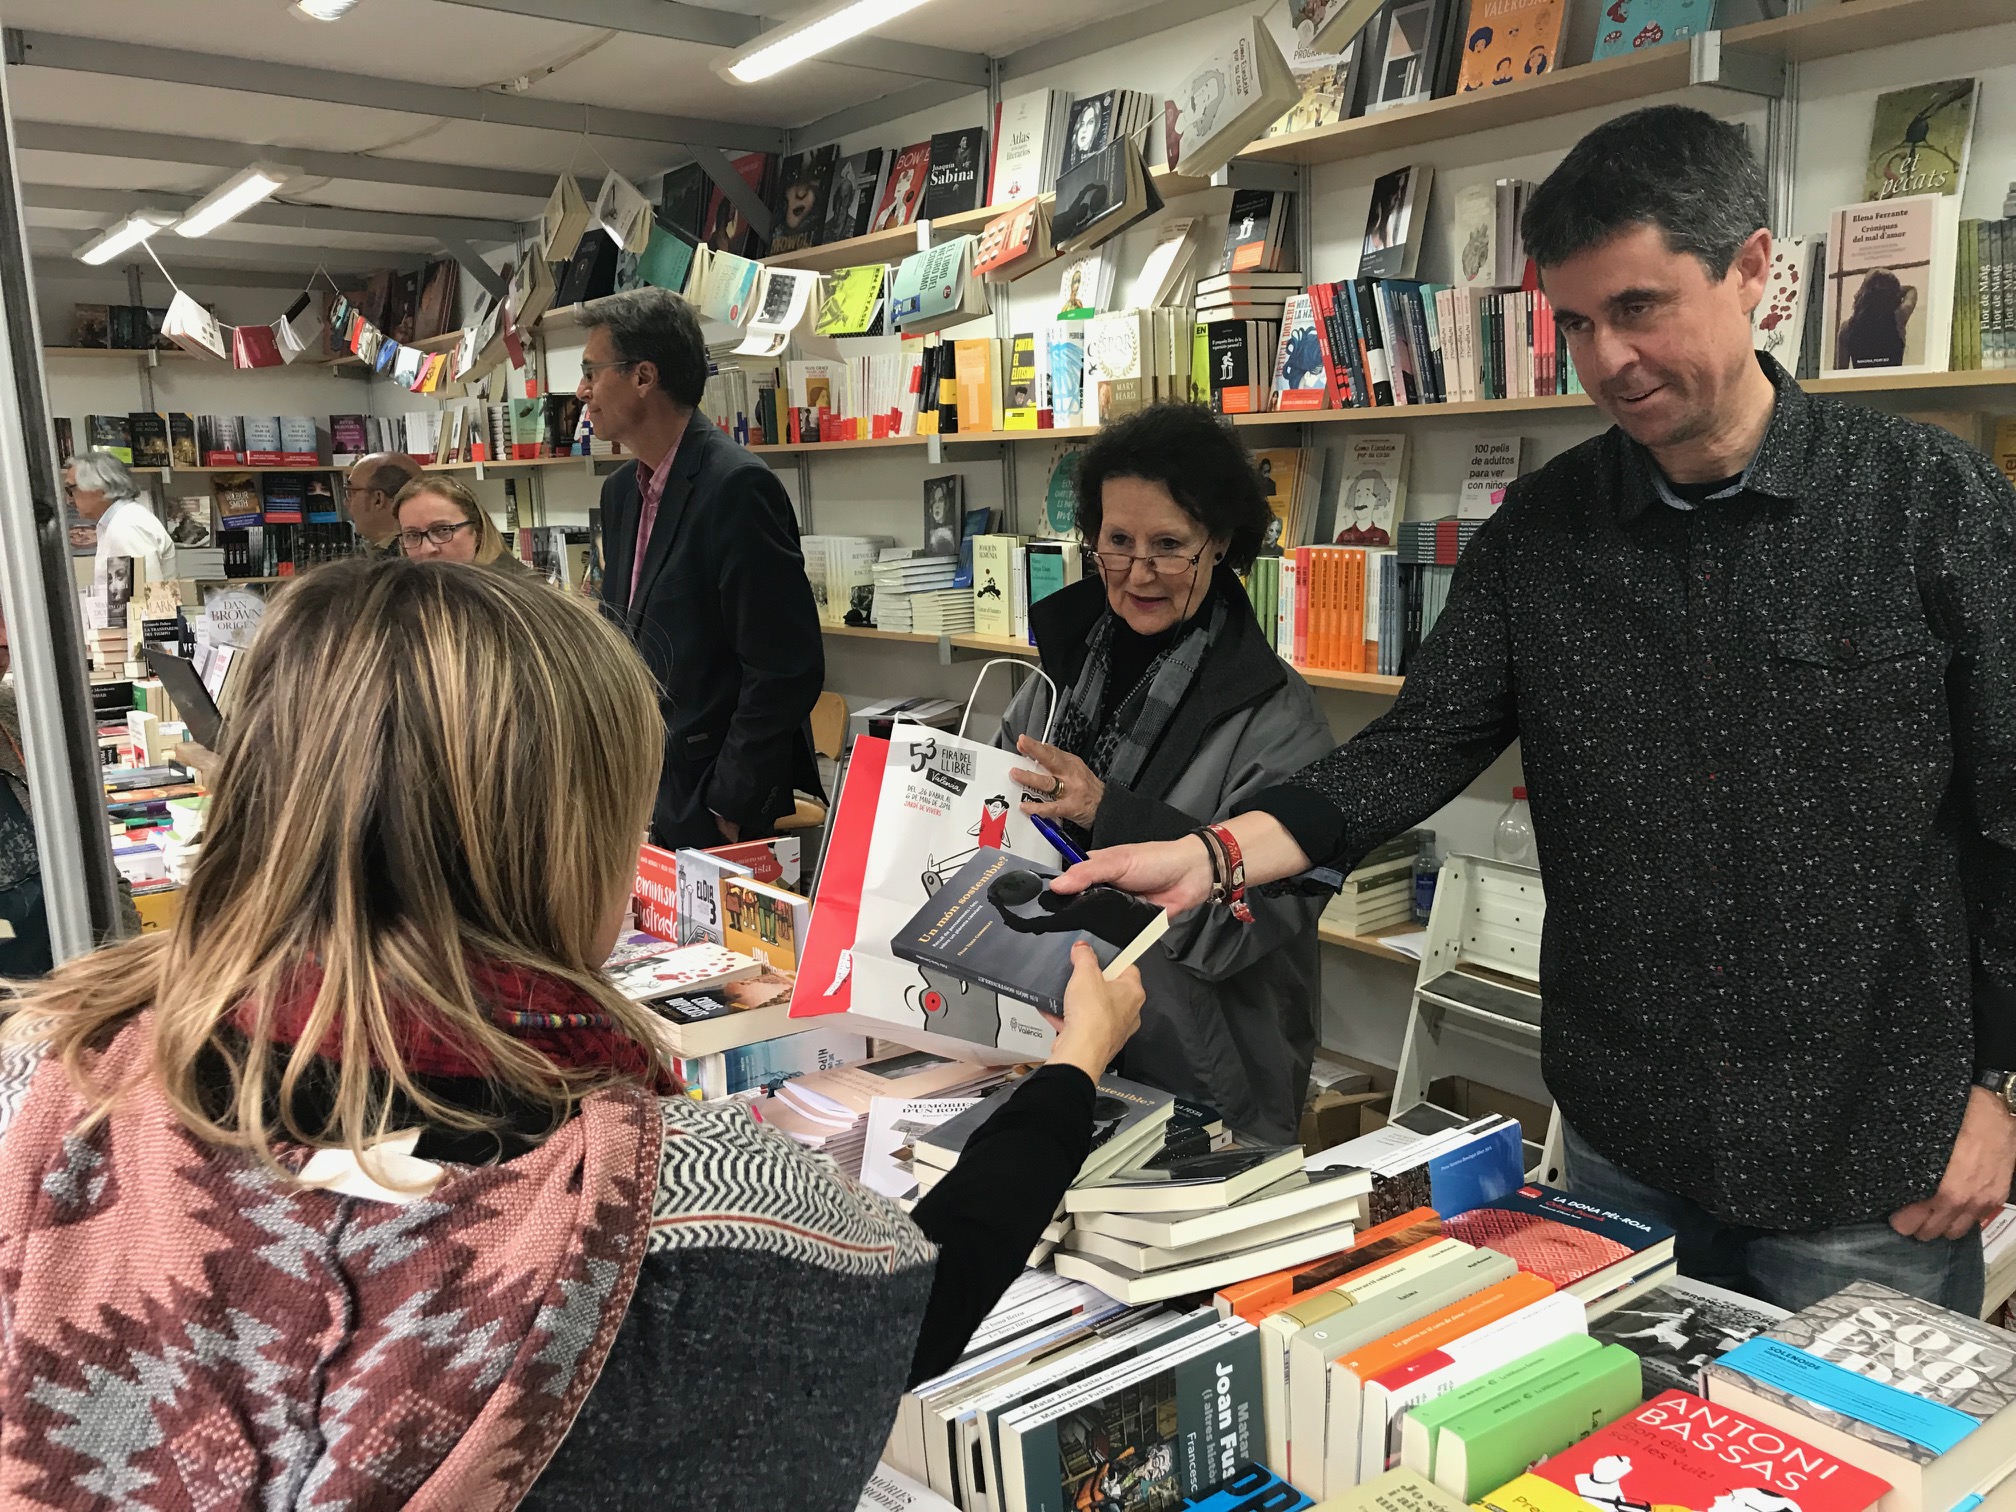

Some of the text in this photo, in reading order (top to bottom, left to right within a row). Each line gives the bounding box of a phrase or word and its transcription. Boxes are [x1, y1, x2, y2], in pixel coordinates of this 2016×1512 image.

[1009, 131, 1030, 146] Atlas
[1900, 151, 1921, 173] et
[930, 168, 974, 186] Sabina
[1880, 167, 1950, 200] pecats
[1853, 208, 1909, 223] Elena Ferrante
[1852, 230, 1907, 243] del mal d'amor
[920, 250, 937, 291] CONSUMO
[939, 253, 952, 279] LIBRO
[1979, 265, 1990, 330] Flor de Maig
[1991, 265, 2002, 330] Flor de Maig
[2003, 263, 2014, 329] Flor de Maig
[1196, 326, 1207, 335] EN
[1102, 334, 1133, 353] SPQR
[1115, 390, 1136, 401] BEARD
[1116, 382, 1134, 391] MARY
[1474, 443, 1510, 455] 100 pelis
[1471, 456, 1514, 465] de adultos
[1468, 481, 1508, 490] con niños
[1469, 471, 1489, 479] para
[224, 491, 249, 500] WILBUR
[229, 500, 249, 510] SMITH
[212, 609, 261, 621] BROWN
[224, 601, 247, 609] DAN
[218, 621, 258, 631] ORIGEN
[910, 737, 937, 773] 53
[941, 748, 971, 764] FIRA DEL
[941, 759, 971, 776] LLIBRE
[907, 785, 916, 793] DEL
[919, 787, 928, 795] 26
[926, 806, 942, 816] VIVERS
[635, 875, 677, 909] eminism
[918, 928, 939, 943] Un
[936, 905, 960, 928] món
[958, 855, 1009, 905] sostenible?
[709, 898, 717, 925] 3
[1553, 1196, 1567, 1204] LA
[1567, 1201, 1601, 1214] DONA
[1602, 1210, 1652, 1233] PÈL-ROJA
[1402, 1333, 1421, 1345] guerra
[1444, 1317, 1452, 1325] de
[1452, 1311, 1465, 1321] dona
[1767, 1345, 1822, 1371] SOLENOIDE
[1029, 1394, 1056, 1410] Matar
[1057, 1386, 1077, 1402] Joan
[1077, 1375, 1103, 1390] Fuster
[1041, 1405, 1068, 1420] Matar
[1068, 1397, 1088, 1411] Joan
[1088, 1384, 1114, 1399] Fuster
[1204, 1402, 1214, 1442] altres
[1216, 1361, 1238, 1480] Joan Fus
[1238, 1401, 1249, 1459] Matar
[1622, 1421, 1658, 1441] Bon
[1636, 1407, 1809, 1492] BASSAS
[1656, 1397, 1841, 1481] ANTONI
[1187, 1431, 1198, 1493] Francesc
[1608, 1430, 1715, 1480] són les vuit!
